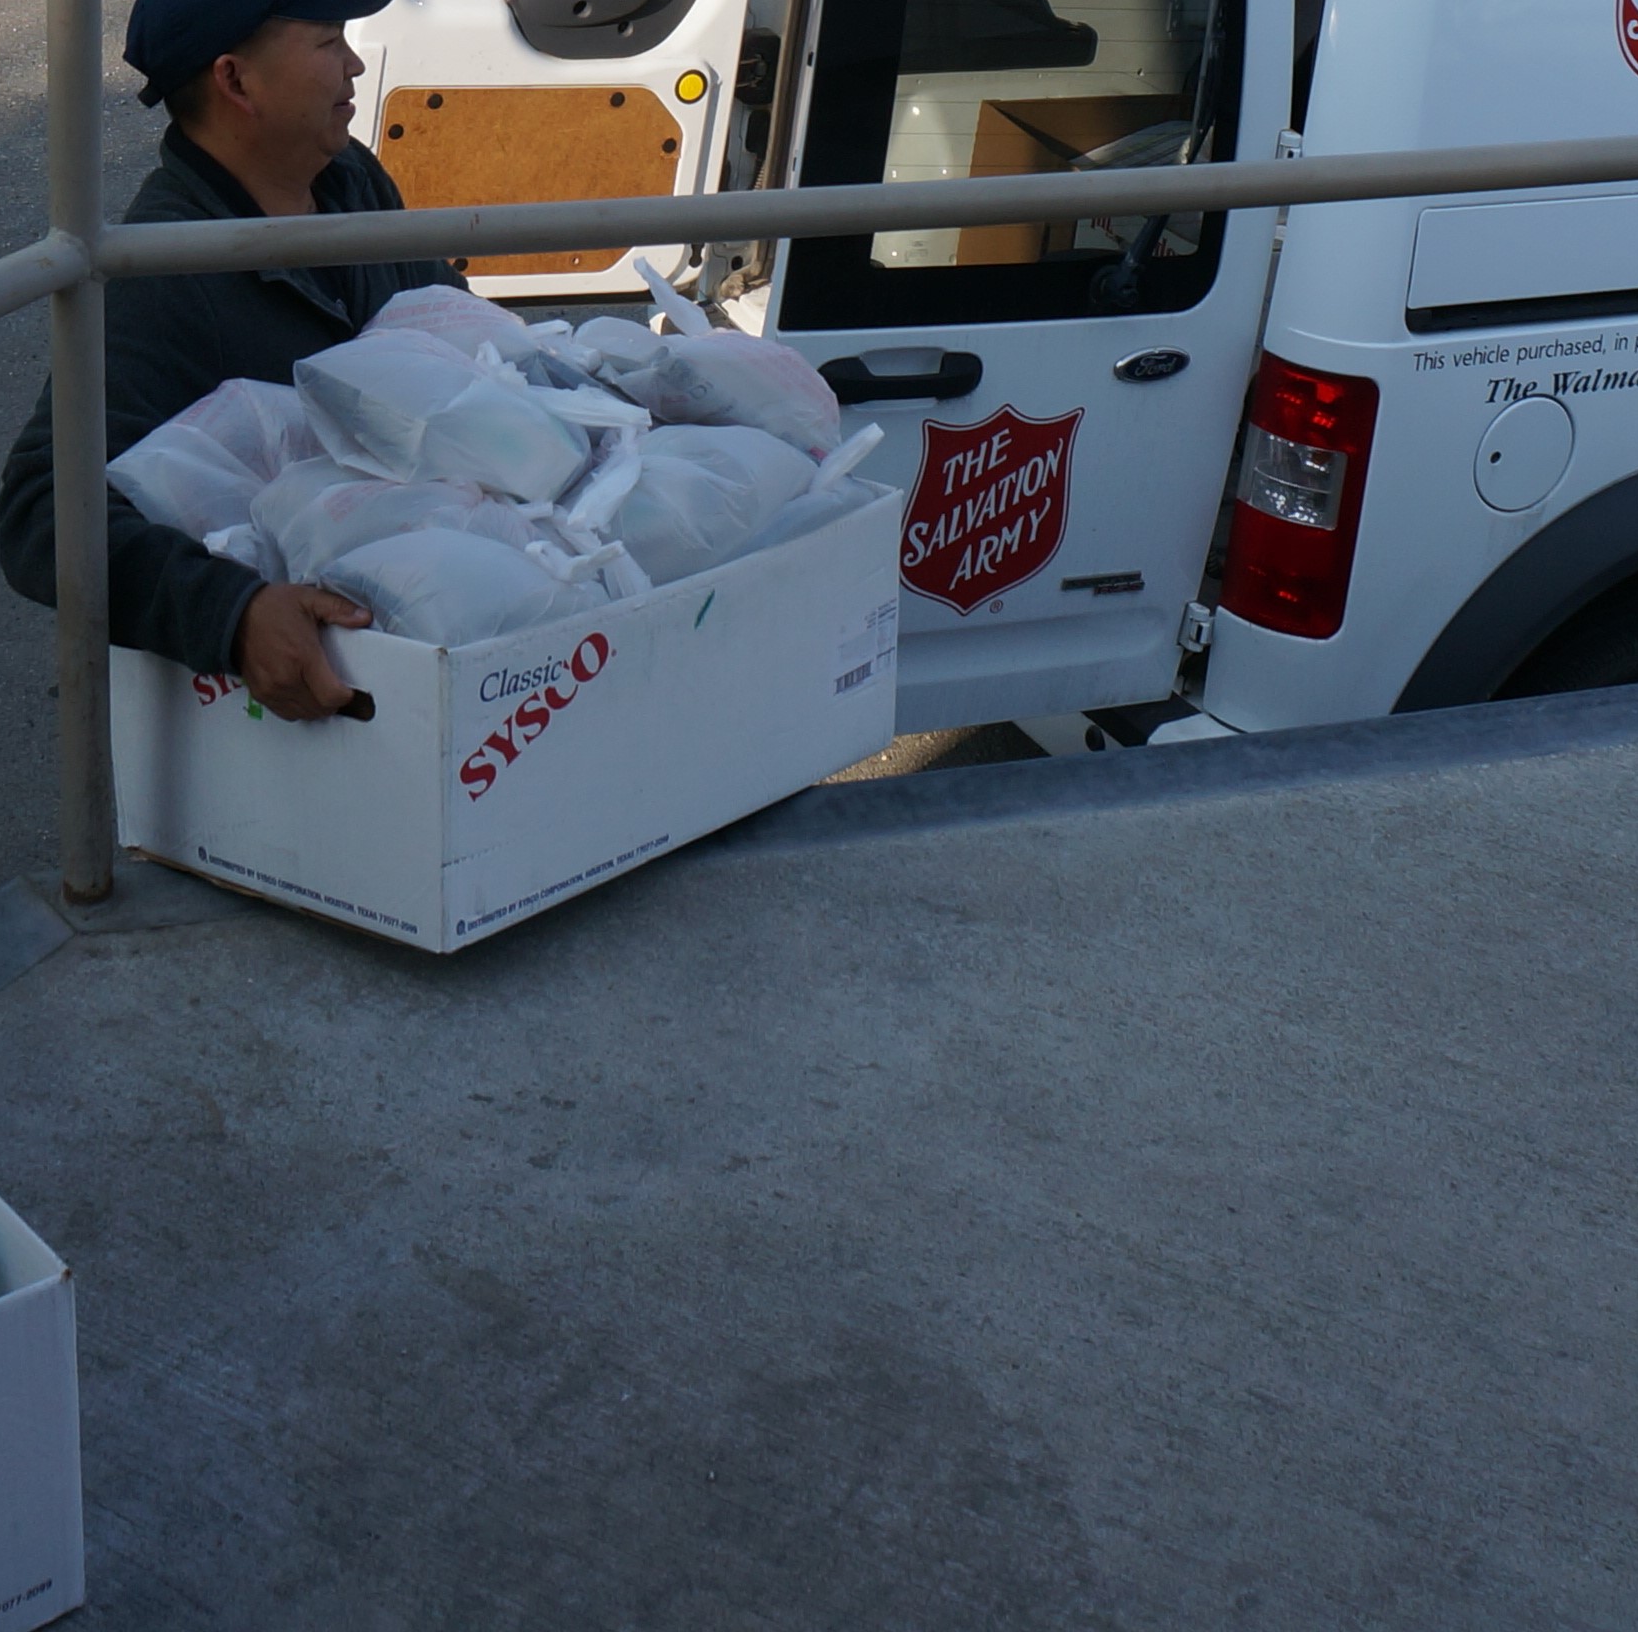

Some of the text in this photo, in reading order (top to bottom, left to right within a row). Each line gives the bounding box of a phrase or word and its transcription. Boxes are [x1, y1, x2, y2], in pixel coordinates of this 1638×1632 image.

[1413, 351, 1445, 372] This
[1453, 345, 1510, 367] vehicle
[1516, 333, 1607, 365] purchased,
[1614, 332, 1628, 351] in
[1485, 375, 1538, 404] The
[942, 428, 1013, 496] THE
[903, 437, 1064, 567] SALVATION
[949, 496, 1052, 591] ARMY
[479, 655, 563, 703] Classic
